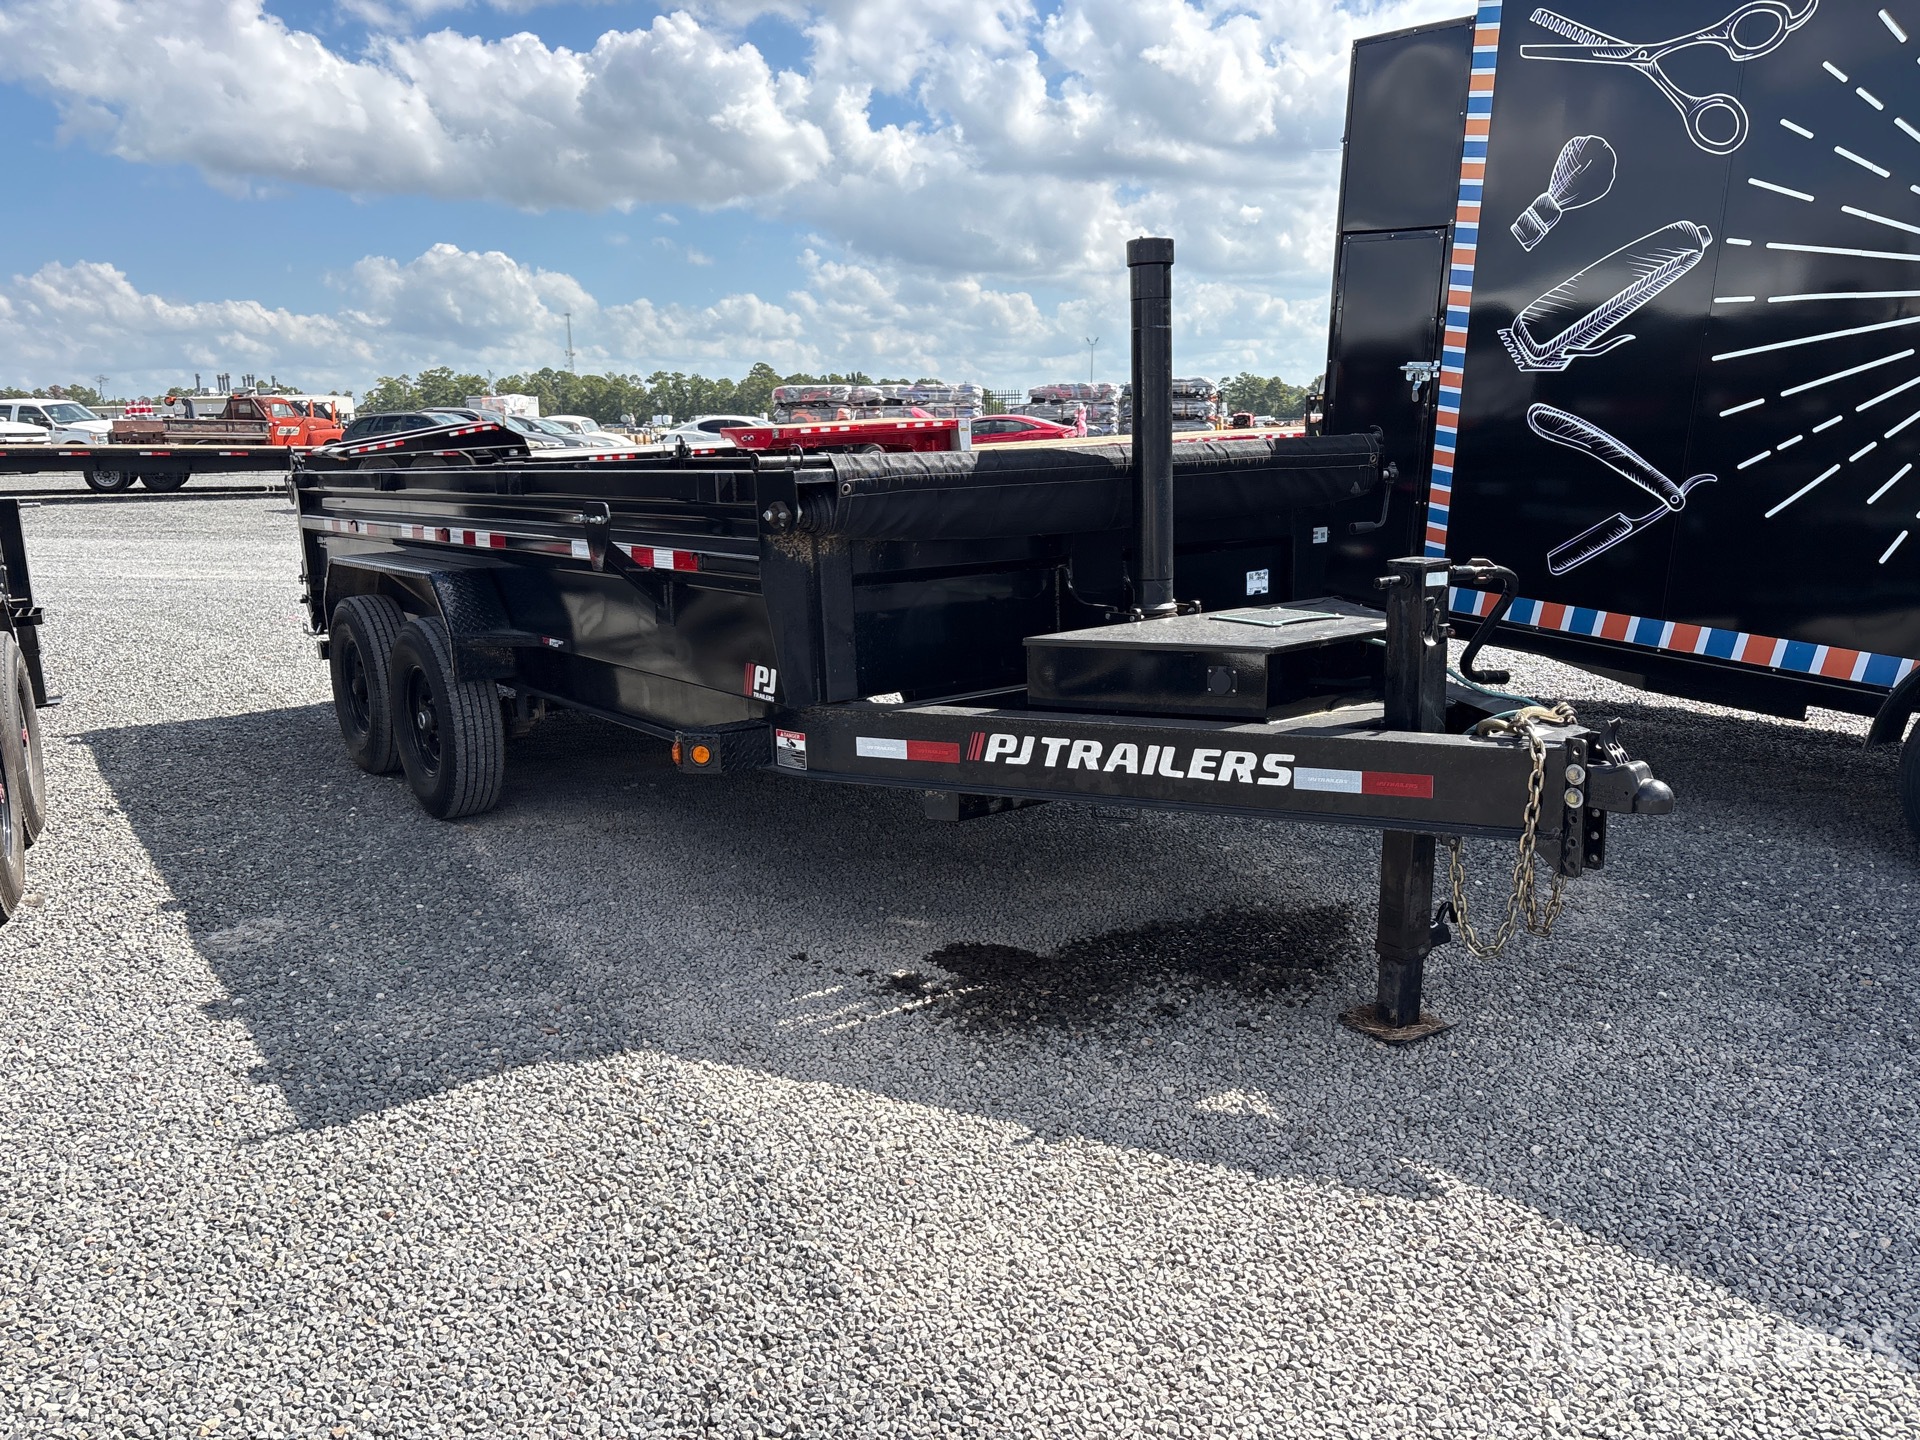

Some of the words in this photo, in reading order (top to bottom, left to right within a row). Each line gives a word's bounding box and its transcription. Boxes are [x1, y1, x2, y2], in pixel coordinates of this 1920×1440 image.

[754, 665, 776, 694] PJ
[753, 691, 775, 703] TRAILERS
[984, 733, 1036, 765] PJ
[1041, 737, 1296, 787] TRAILERS
